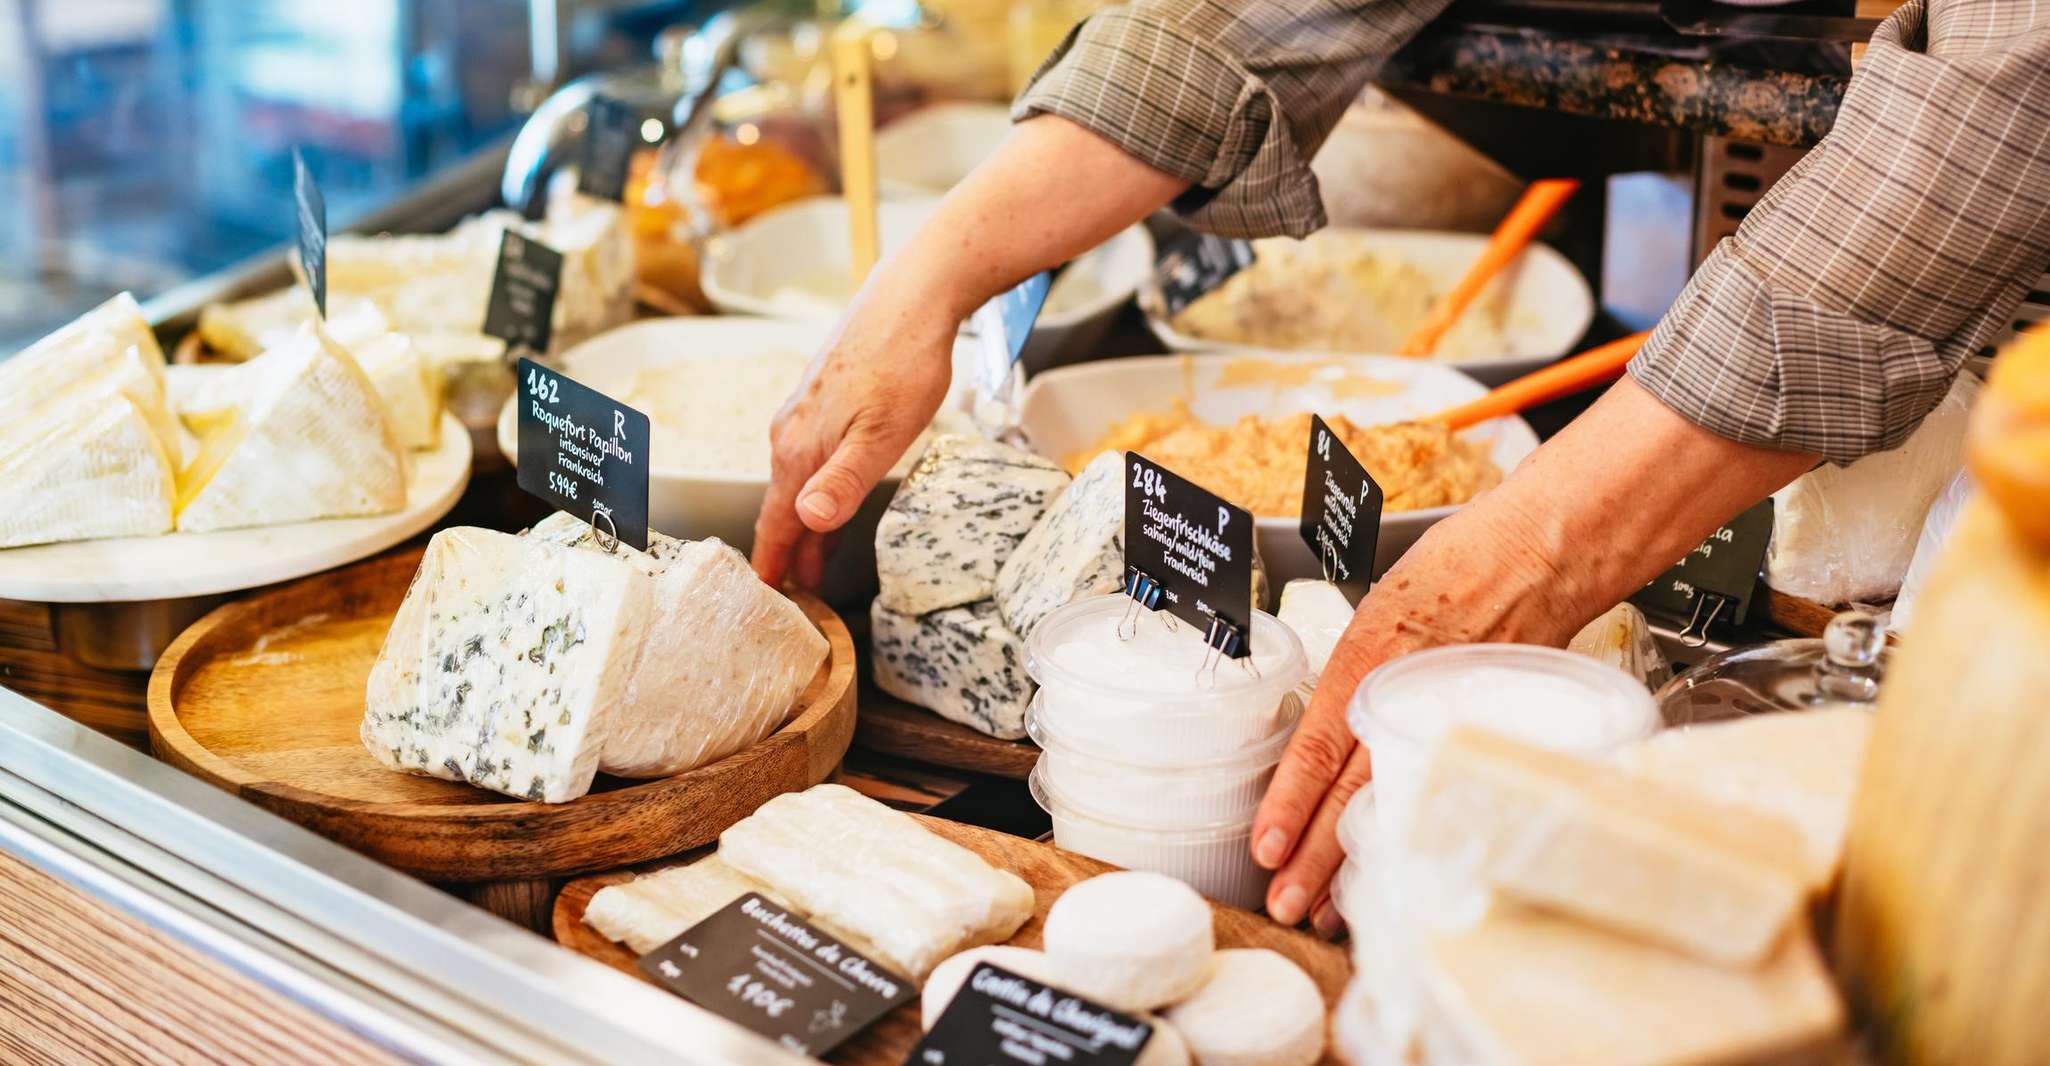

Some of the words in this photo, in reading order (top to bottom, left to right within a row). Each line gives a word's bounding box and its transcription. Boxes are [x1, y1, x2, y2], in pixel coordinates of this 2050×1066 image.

[527, 368, 560, 404] 162
[532, 400, 586, 441] Roquefort
[589, 427, 632, 464] Papillon
[614, 409, 627, 441] R
[559, 434, 604, 467] intensiver
[1317, 429, 1331, 462] 81
[558, 452, 604, 486] Frankreich
[1132, 462, 1167, 504] 284
[1359, 479, 1369, 505] P
[1142, 499, 1233, 562] Ziegenfrischkäse
[1218, 505, 1230, 535] P
[1163, 550, 1209, 588] Frankreich
